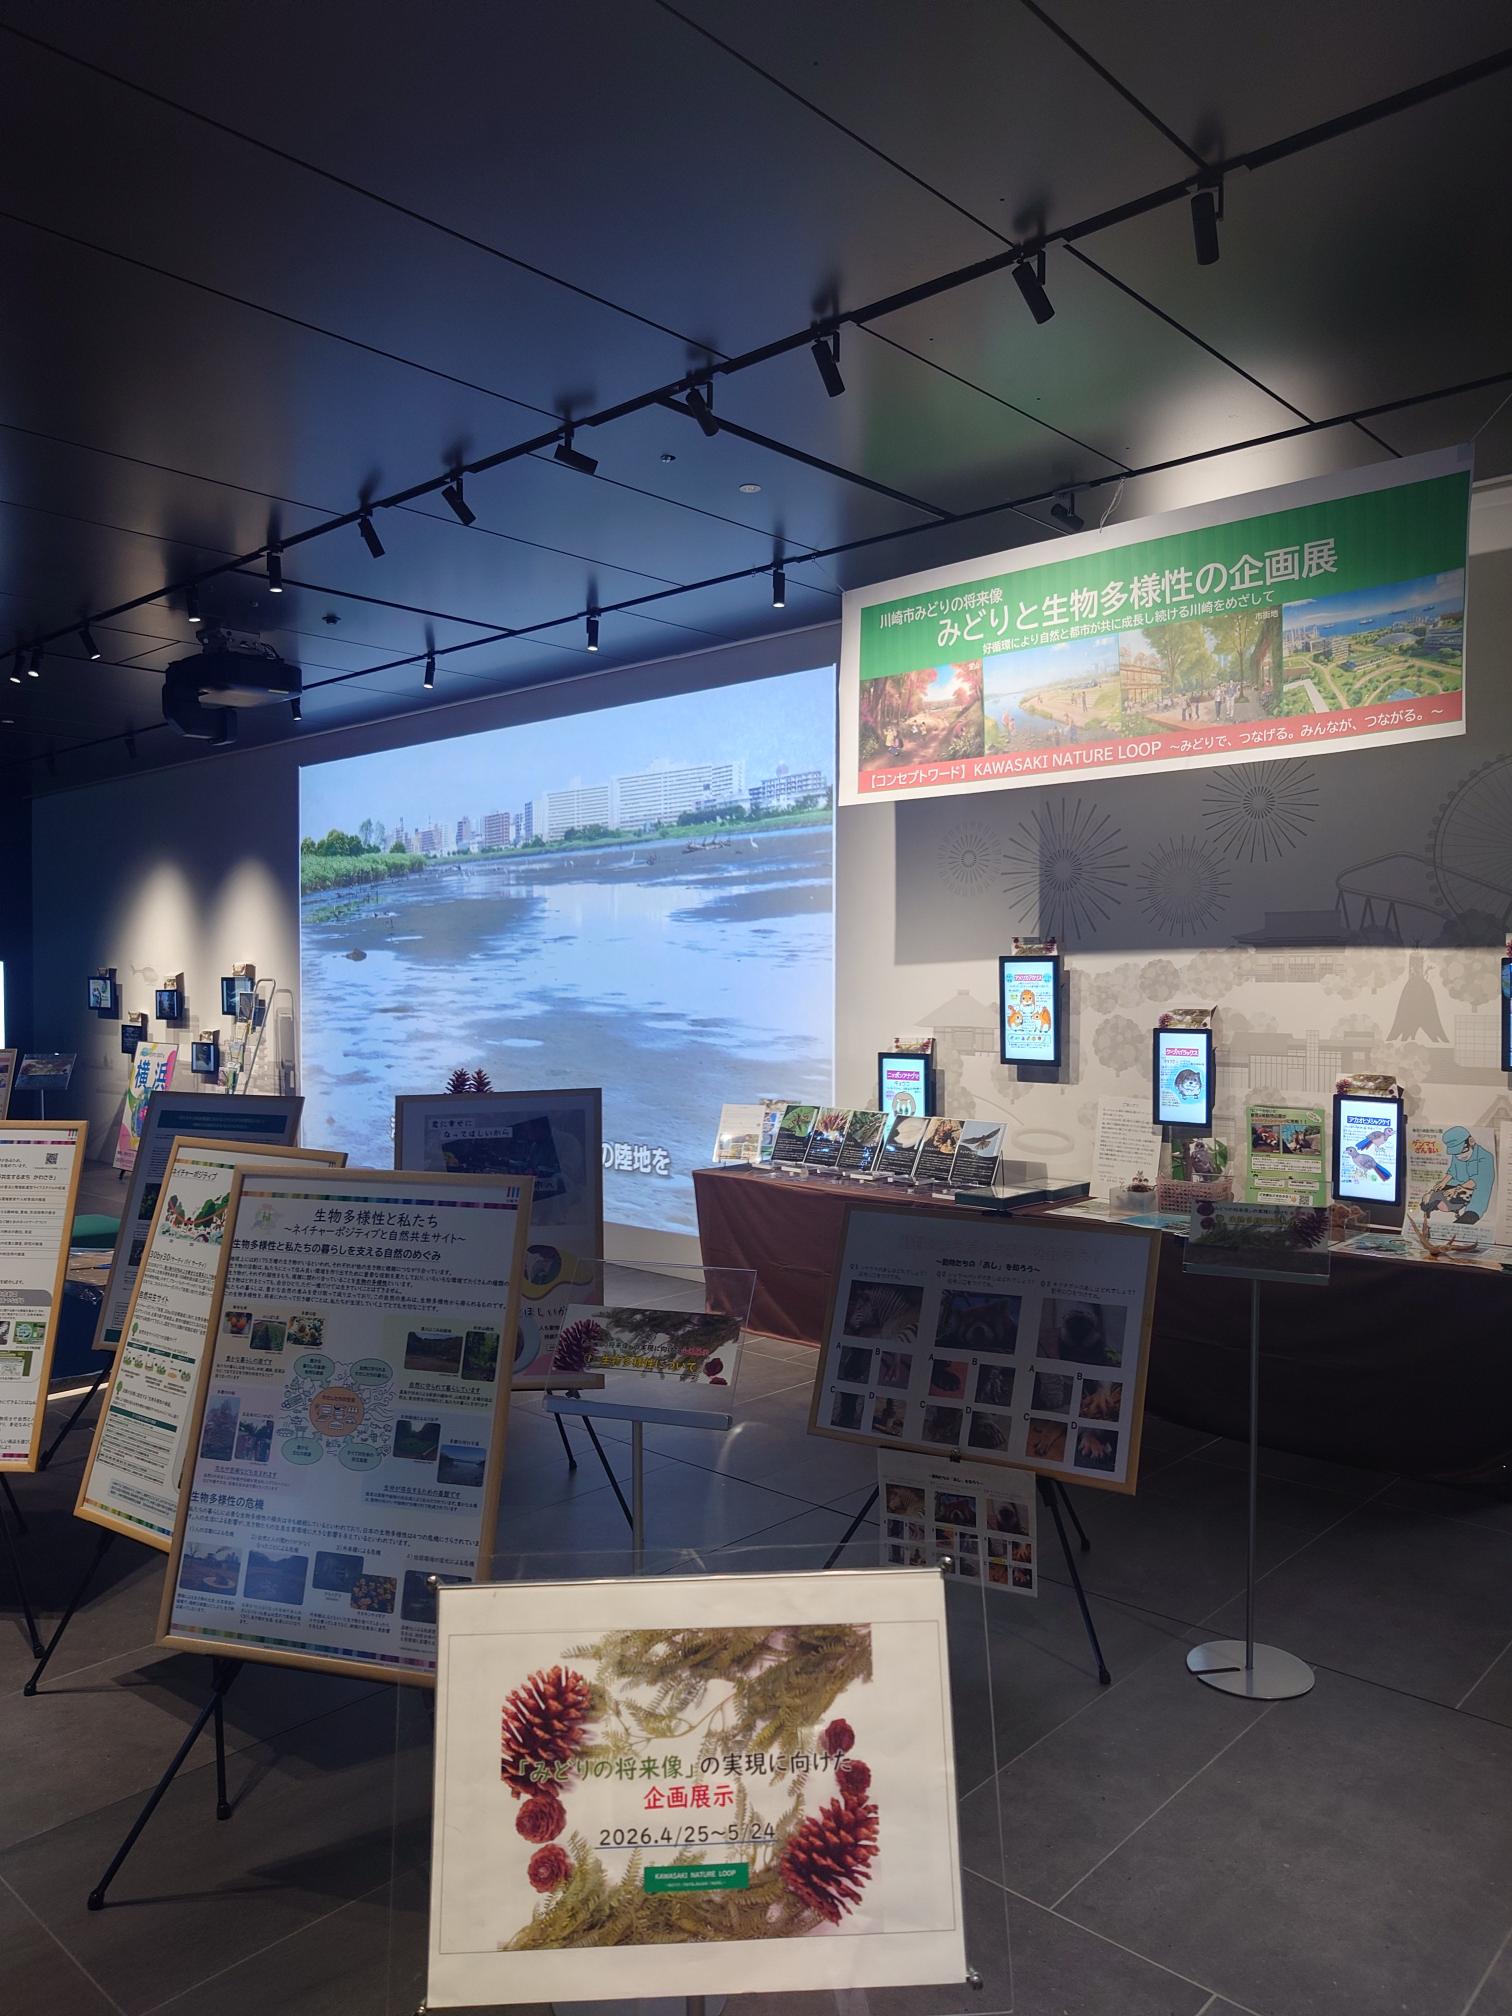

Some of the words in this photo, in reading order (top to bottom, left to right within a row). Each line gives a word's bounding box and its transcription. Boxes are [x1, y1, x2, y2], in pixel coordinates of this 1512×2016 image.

[937, 537, 1339, 648] みどりと生物多様性の企画展
[880, 587, 1003, 630] 川崎市みどりの将来像
[983, 590, 1274, 656] 好循環により自然と都市が共に成長し続ける川崎をめざして
[871, 764, 967, 789] 【コンセプトワード】
[974, 756, 1049, 776] KAWASAKI
[1052, 748, 1113, 768] NATURE
[1118, 741, 1162, 760] LOOP
[134, 1059, 169, 1090] 横浜
[313, 1207, 439, 1229] 生物多様性と私たち
[232, 1239, 441, 1261] 生物多様性と私たちの暮らしを支える自然のめぐみ
[191, 1491, 265, 1510] 生物多様性の危機
[518, 1751, 852, 1784] 「みどりの将来像」の実現に向けた
[644, 1784, 735, 1811] 企画展示
[655, 1871, 689, 1880] KAWASAKI
[690, 1870, 717, 1879] NATURE
[718, 1869, 737, 1878] LOOP
